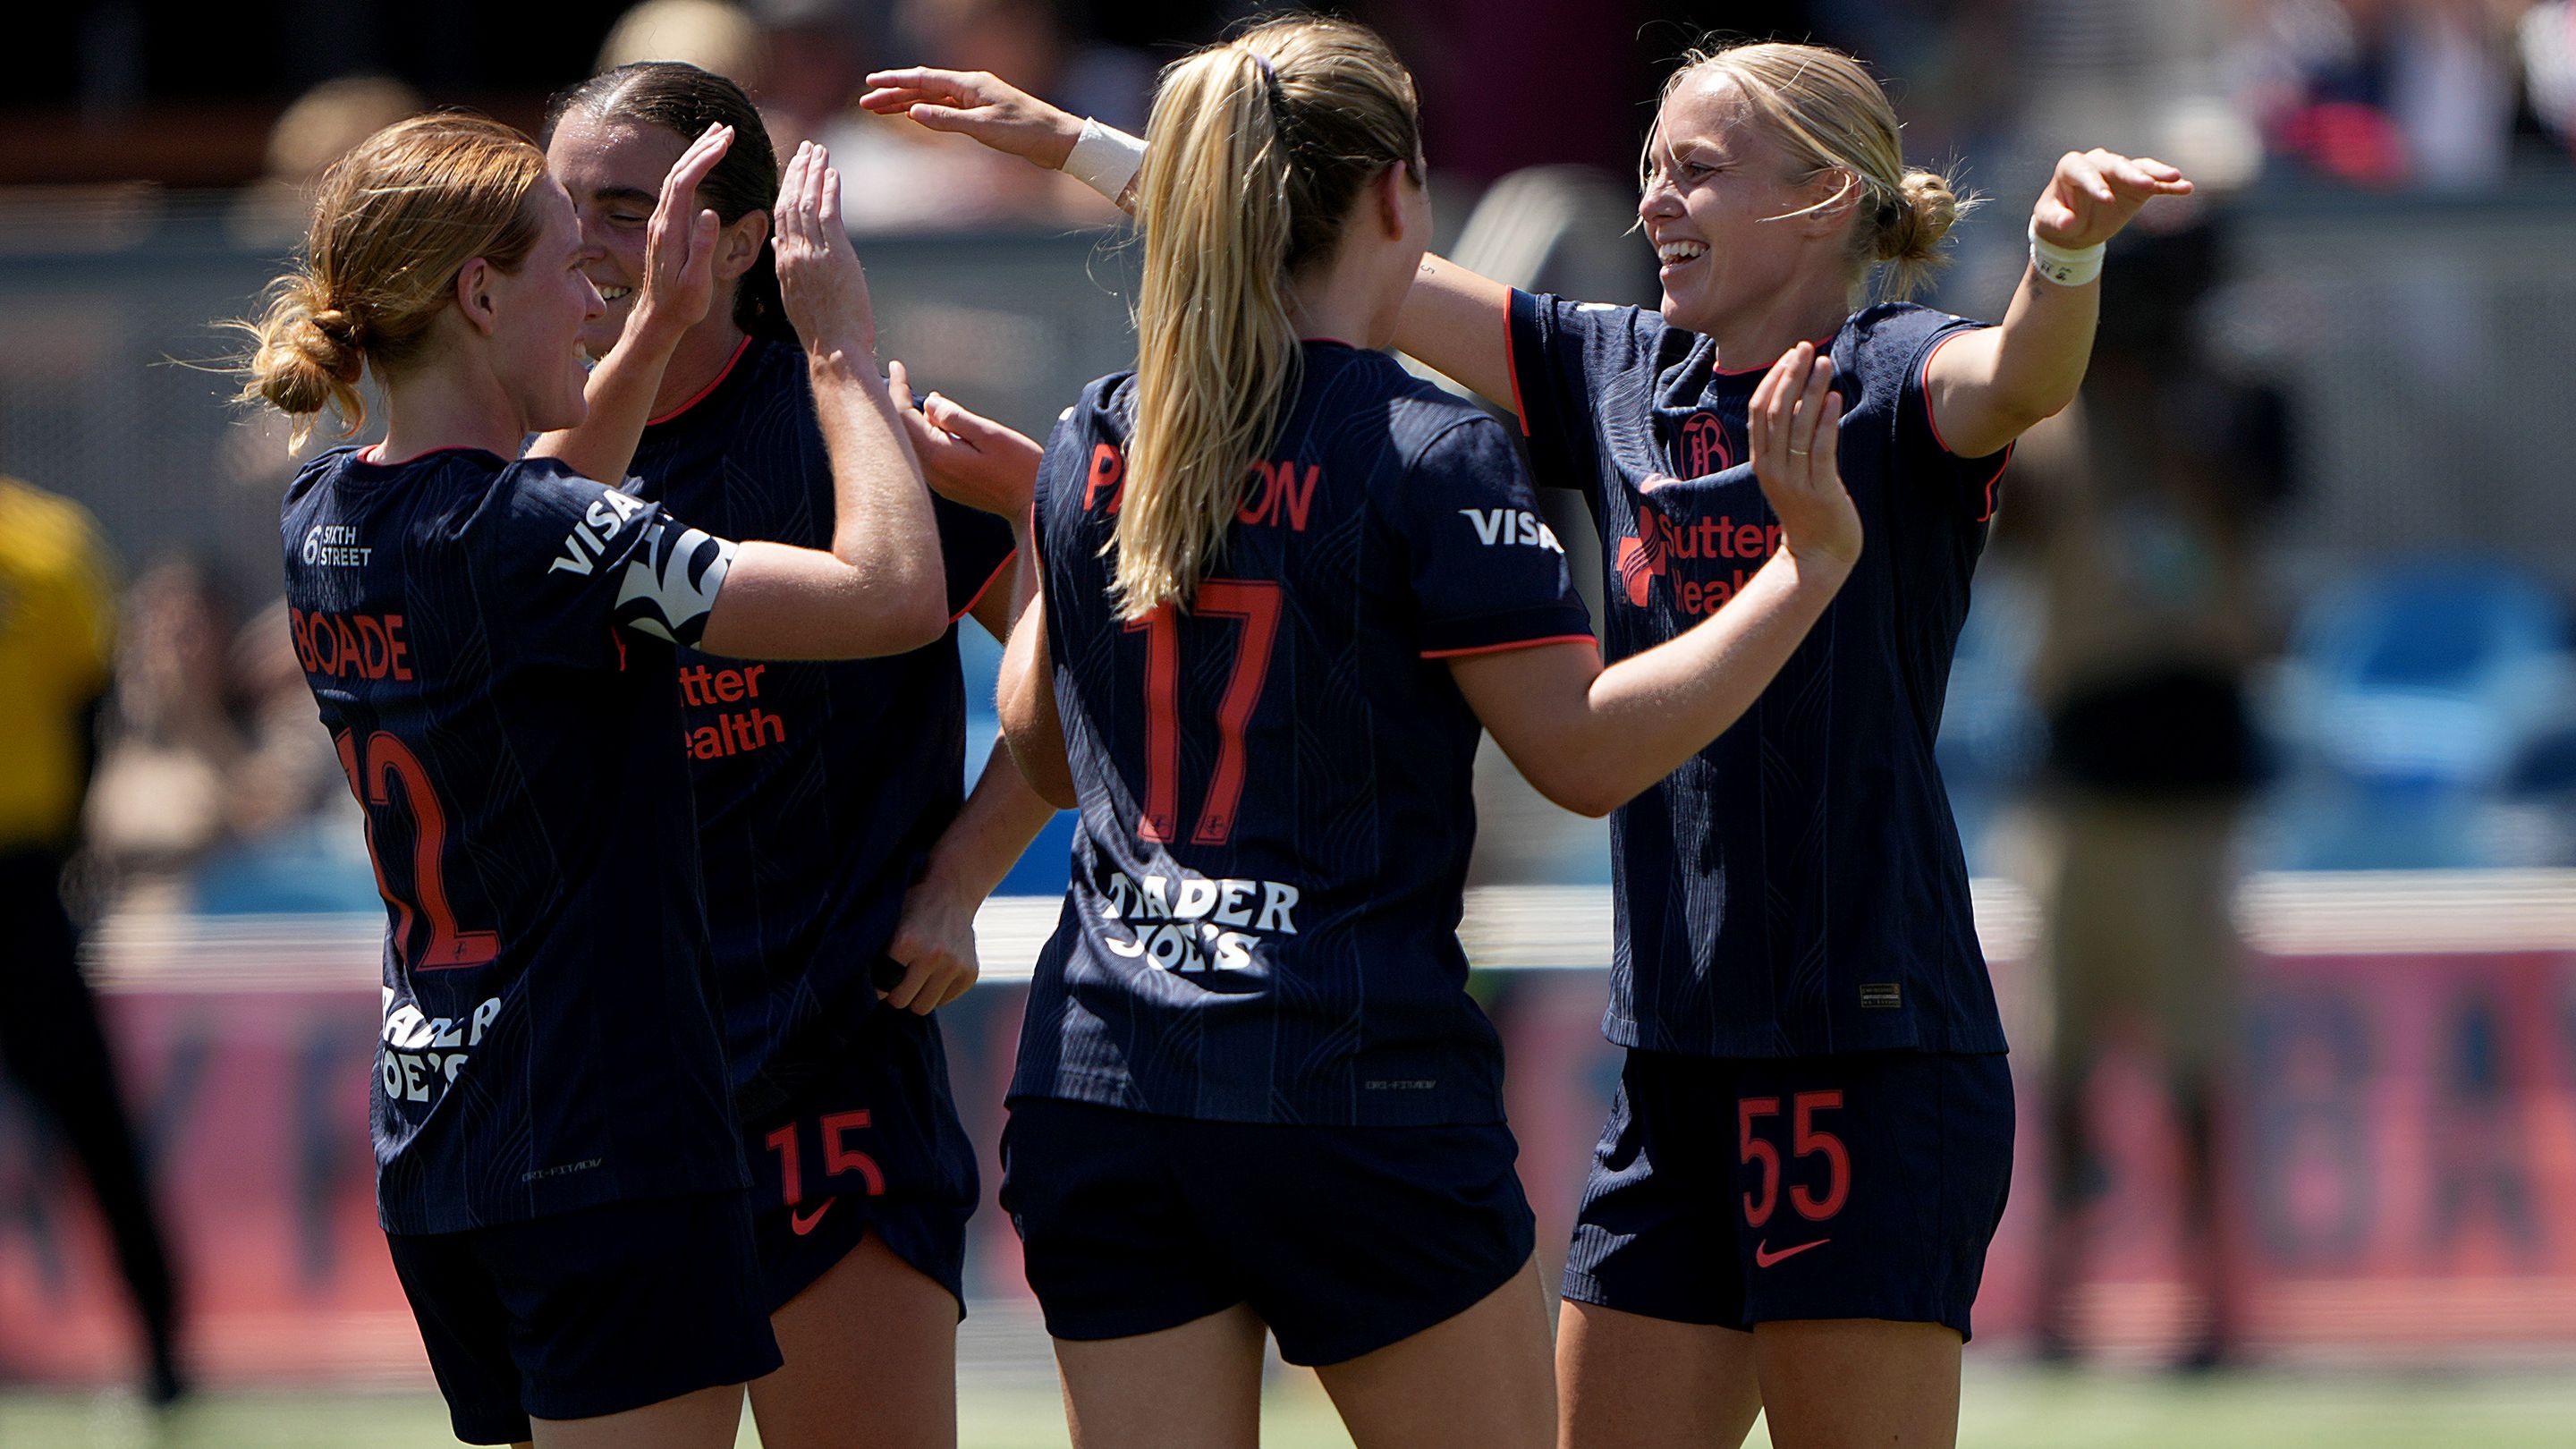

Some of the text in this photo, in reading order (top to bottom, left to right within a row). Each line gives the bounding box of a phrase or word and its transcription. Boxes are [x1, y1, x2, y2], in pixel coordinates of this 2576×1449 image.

[320, 547, 372, 566] STREET
[323, 525, 356, 545] SIXTH
[547, 489, 644, 575] VISA
[1457, 508, 1565, 554] VISA
[1658, 513, 1783, 559] Sutter
[291, 606, 413, 682] BOADE
[680, 664, 766, 708] tter
[684, 708, 785, 759] alth
[1123, 579, 1282, 845] 17
[1105, 923, 1261, 972] JOE'S
[383, 1050, 470, 1103] OE'S
[767, 1109, 885, 1208] 15
[1738, 1089, 1851, 1227] 55
